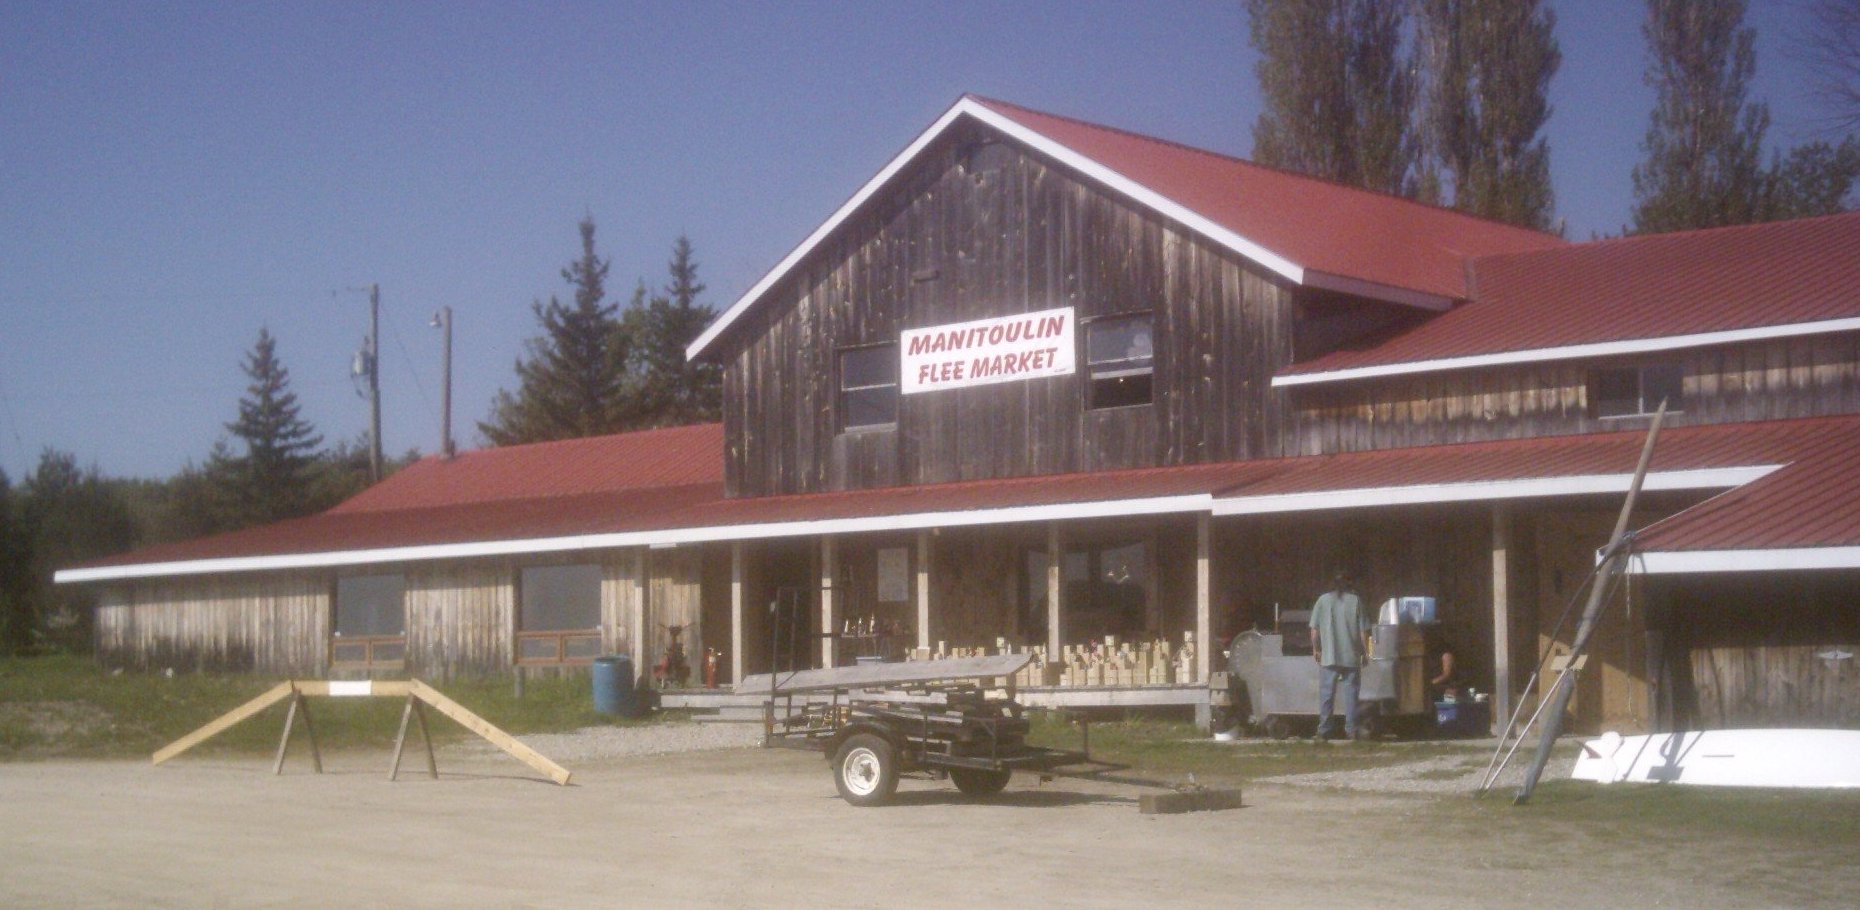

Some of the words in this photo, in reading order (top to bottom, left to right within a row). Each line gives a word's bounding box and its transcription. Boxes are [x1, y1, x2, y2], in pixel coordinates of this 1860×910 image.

[908, 315, 1064, 355] MANITOULIN
[918, 361, 965, 384] FLEE
[970, 347, 1058, 379] MARKET
